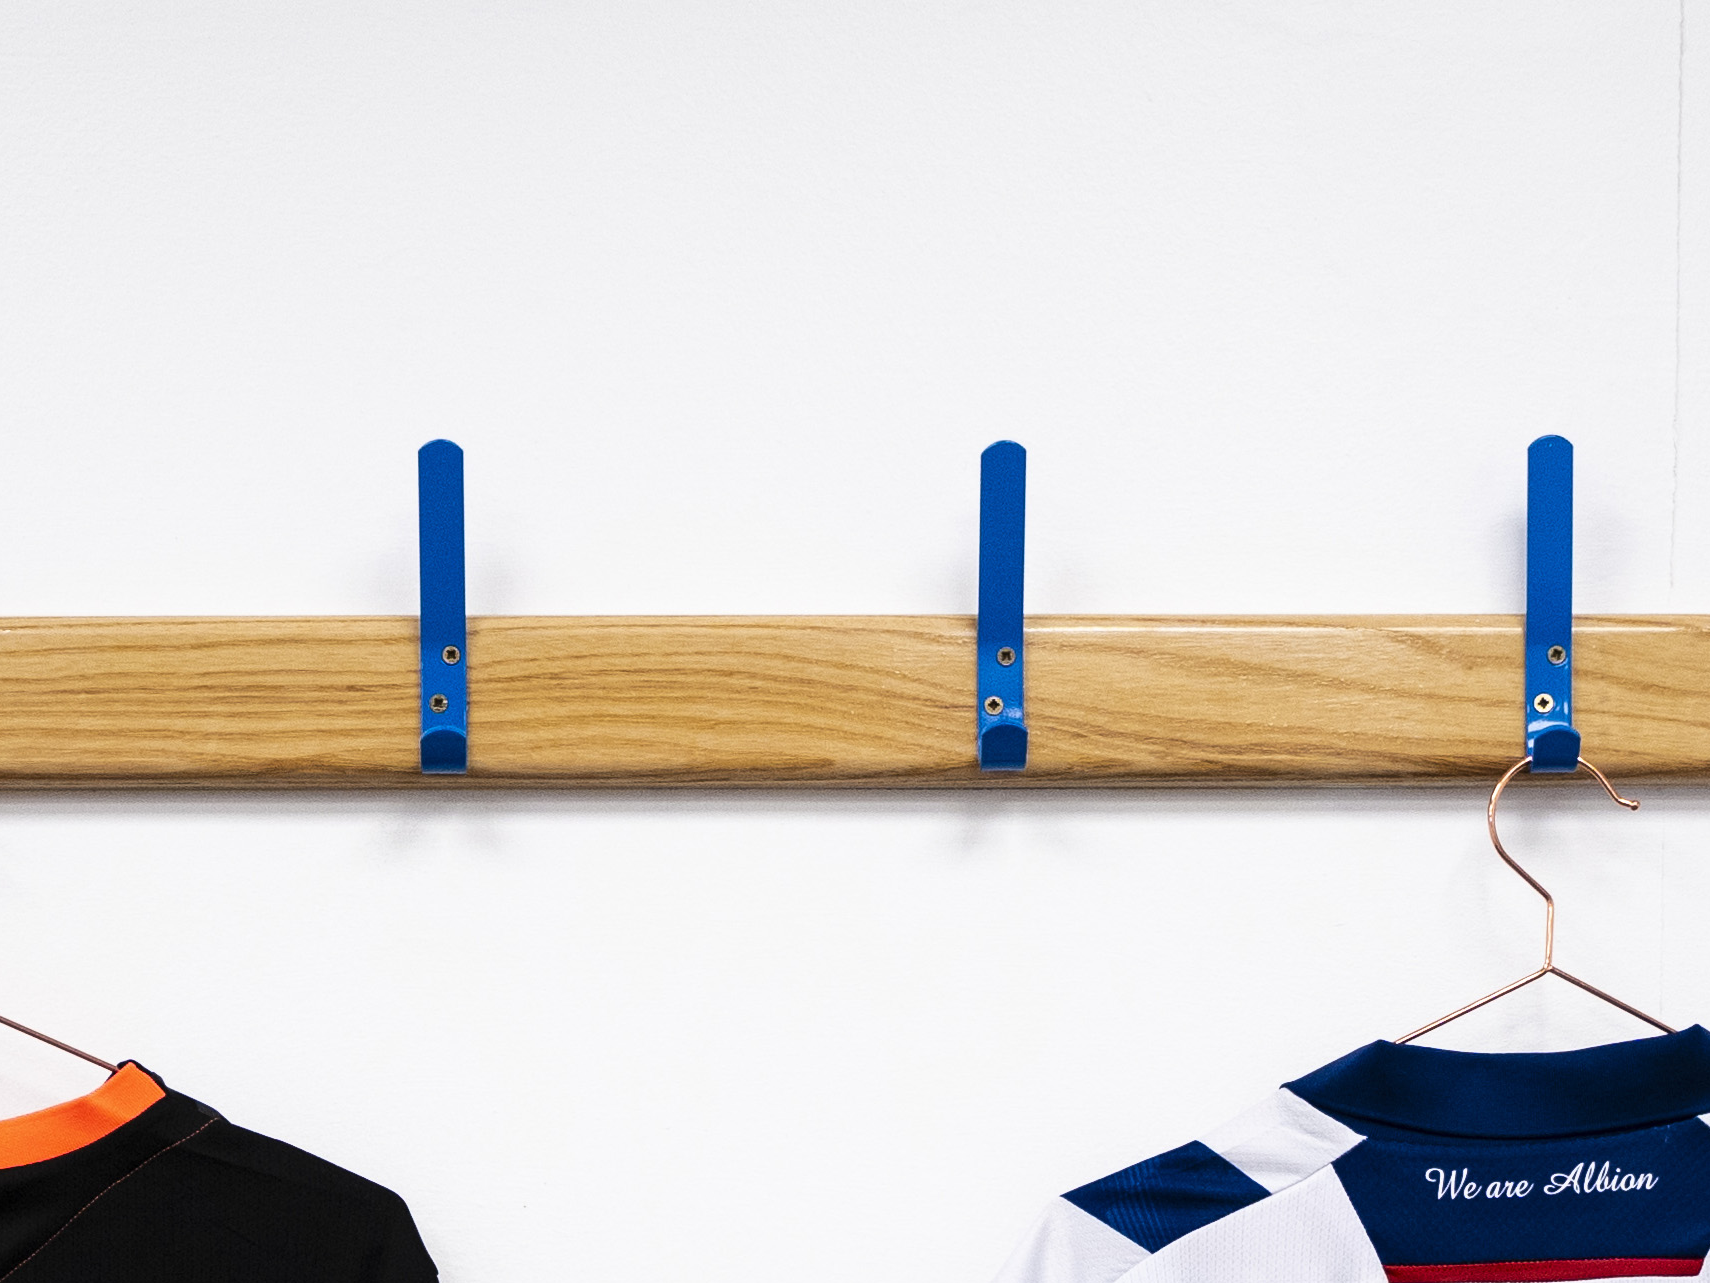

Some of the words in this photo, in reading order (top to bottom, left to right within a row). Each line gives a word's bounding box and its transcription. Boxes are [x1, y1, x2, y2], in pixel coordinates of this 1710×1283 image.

[1425, 1167, 1482, 1200] We
[1486, 1180, 1534, 1198] are
[1543, 1161, 1659, 1195] Albion
